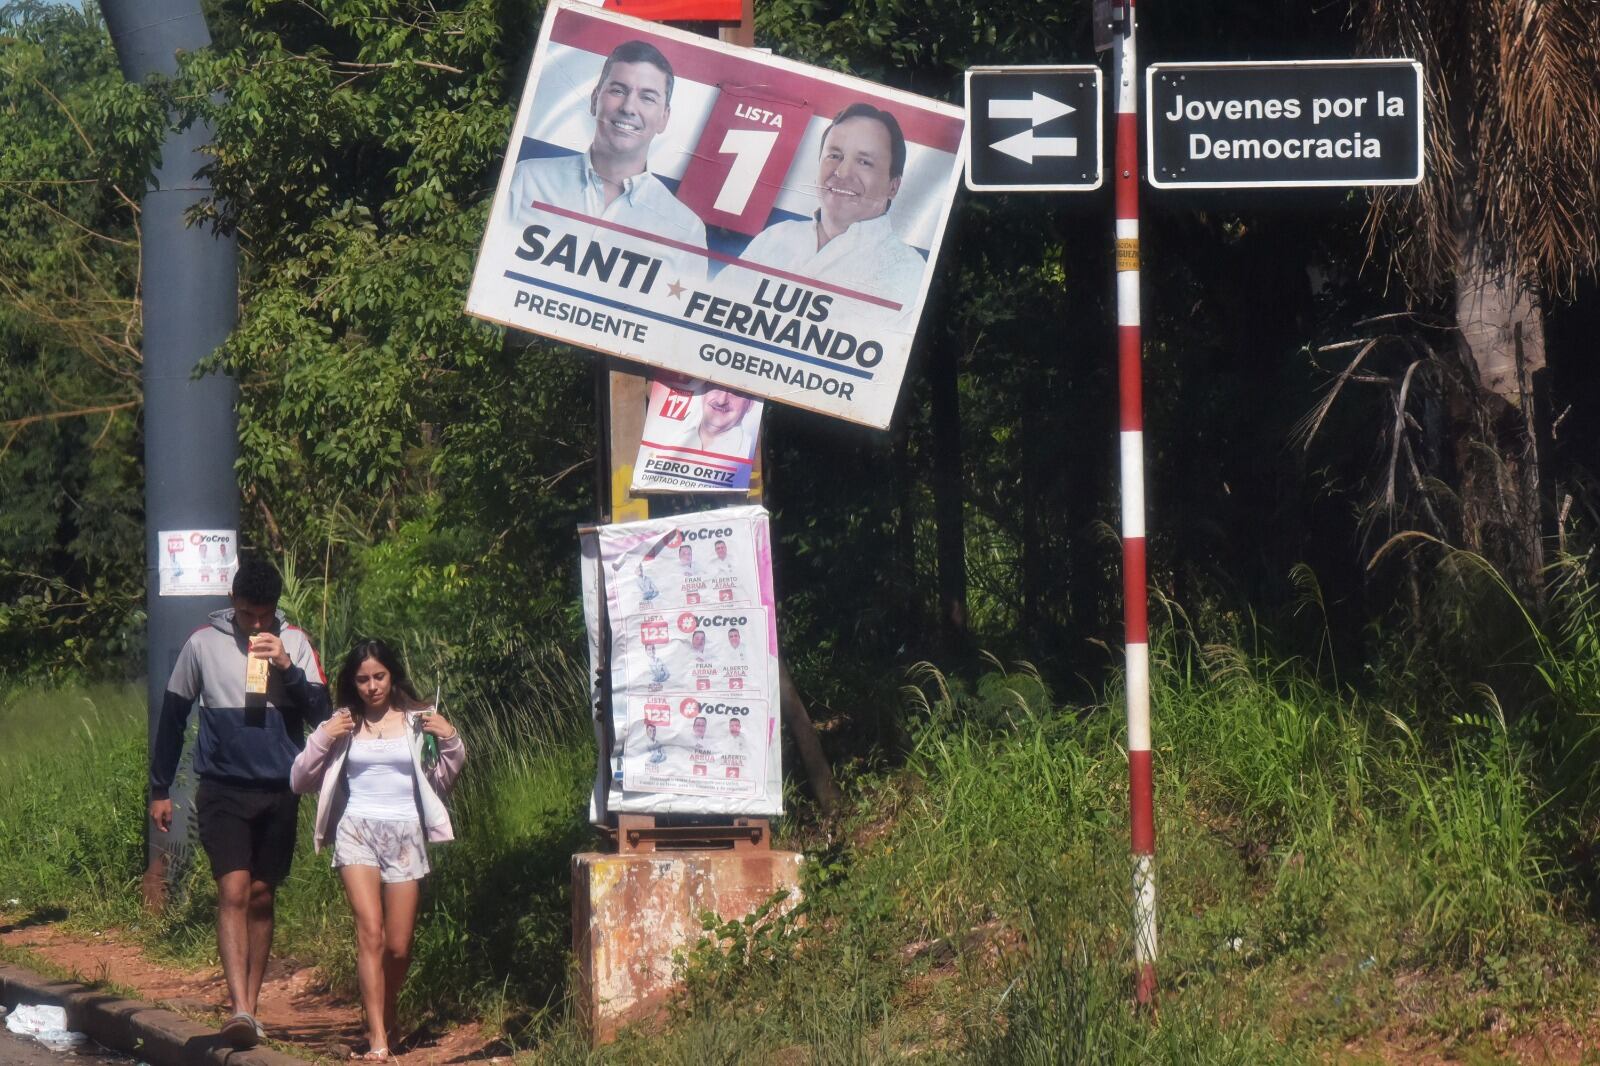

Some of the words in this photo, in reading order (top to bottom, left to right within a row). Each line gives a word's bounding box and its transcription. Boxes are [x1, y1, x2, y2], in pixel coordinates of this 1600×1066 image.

[735, 103, 784, 128] LISTA
[1166, 94, 1300, 121] Jovenes
[1312, 97, 1367, 124] por
[1378, 91, 1404, 117] la
[1189, 132, 1380, 159] Democracia
[713, 128, 779, 216] 1
[514, 224, 663, 295] SANTI
[513, 289, 648, 344] PRESIDENTE
[753, 278, 833, 322] LUIS
[684, 291, 883, 369] FERNANDO
[698, 343, 856, 401] GOBERNADOR
[666, 394, 690, 418] 17
[642, 474, 678, 486] DIPUTADO
[680, 480, 696, 488] POR
[645, 459, 690, 474] PEDRO
[694, 466, 736, 482] ORTIZ
[642, 626, 668, 640] 123
